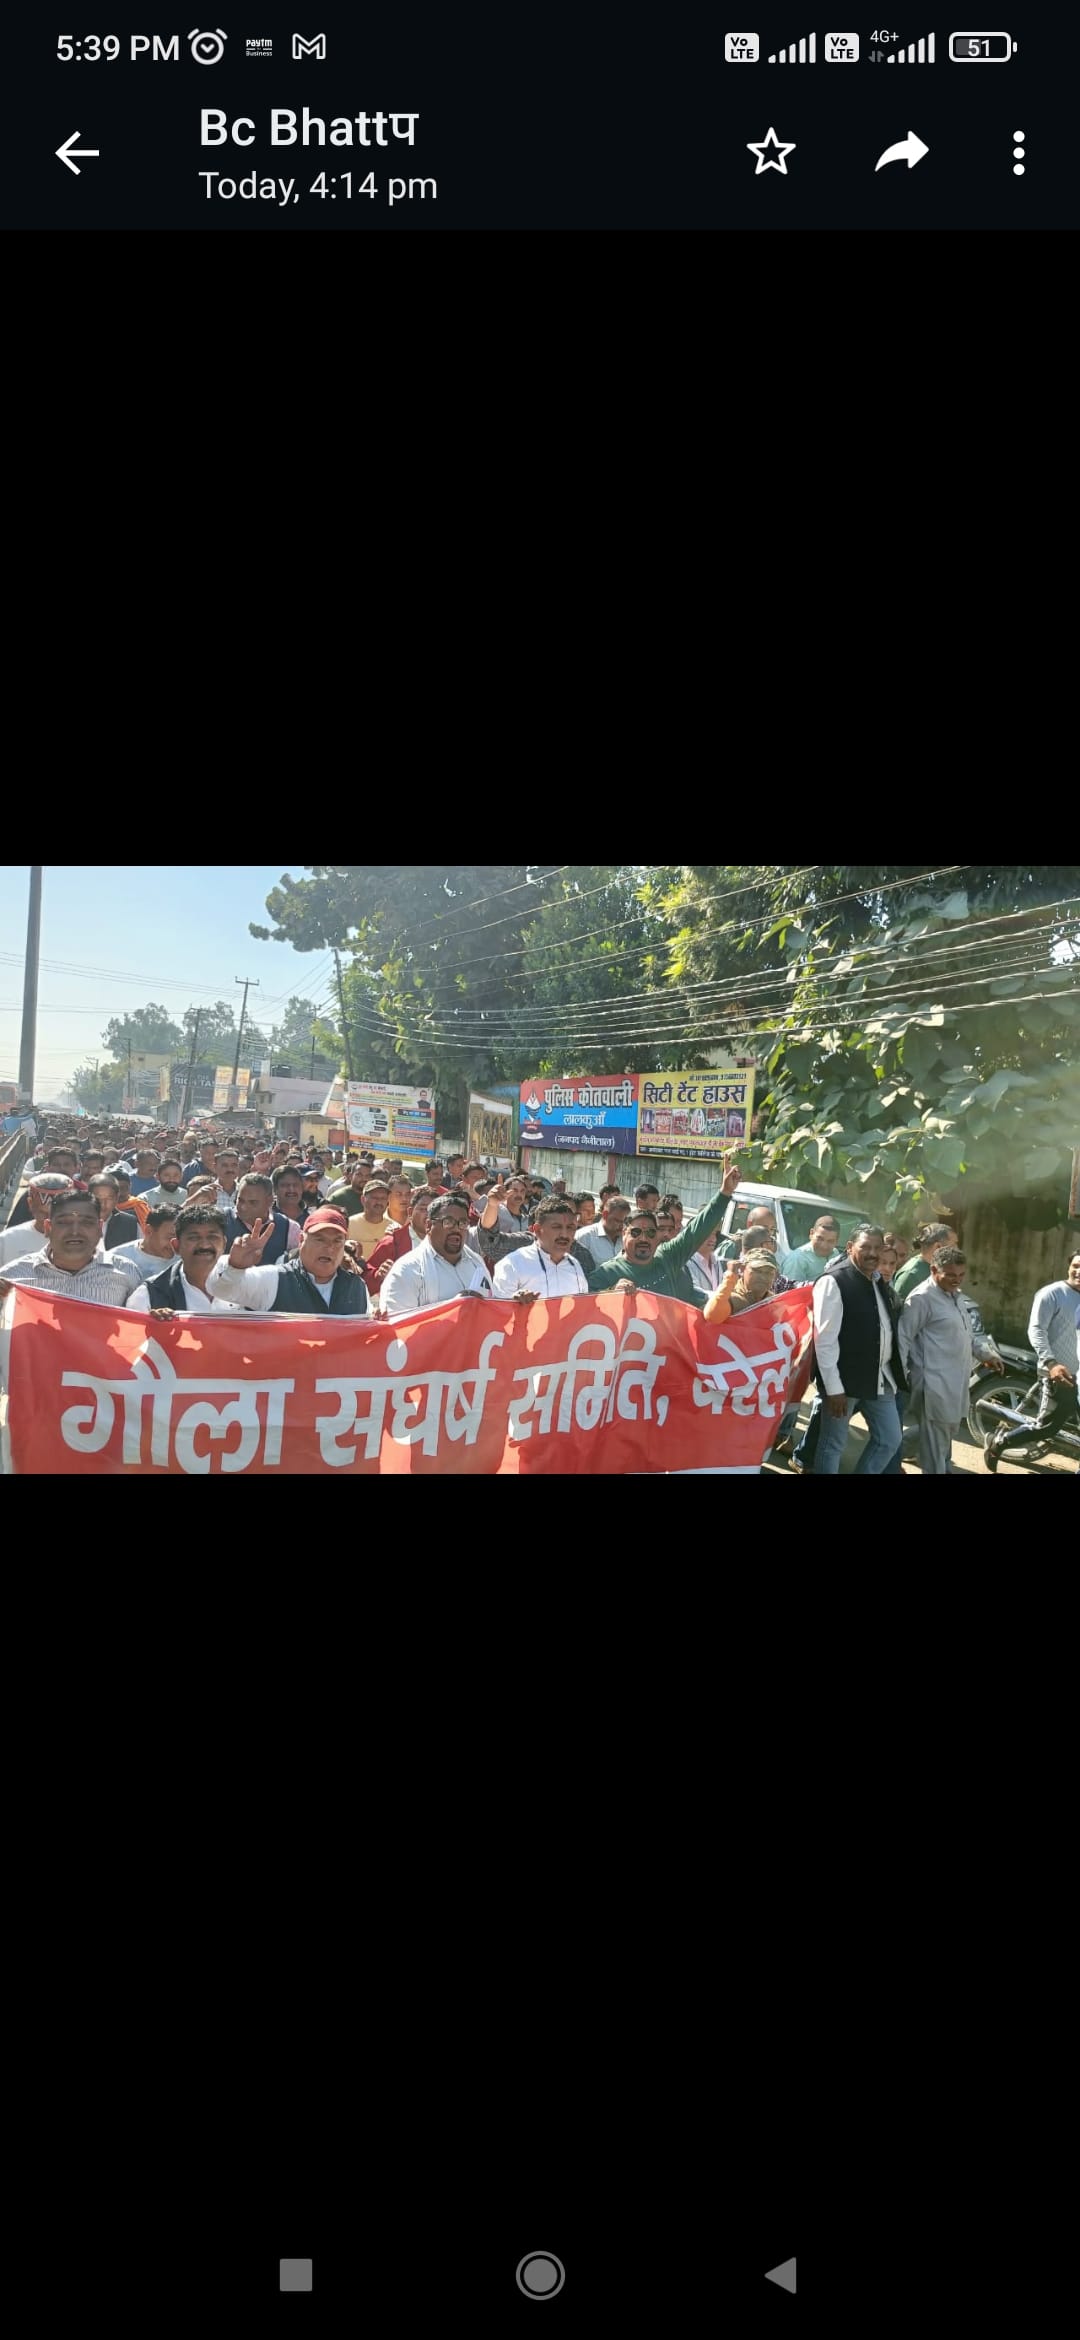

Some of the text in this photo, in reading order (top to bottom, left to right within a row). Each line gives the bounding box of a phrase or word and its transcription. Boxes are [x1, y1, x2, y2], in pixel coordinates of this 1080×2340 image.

[544, 1079, 634, 1114] पुलिस कोतवाली
[643, 1079, 748, 1105] सिटी टेंट हाउस
[563, 1111, 607, 1130] लालकुआँ
[60, 1336, 296, 1474] गौला
[315, 1331, 505, 1467] संघर्ष
[507, 1317, 670, 1441] समिति,
